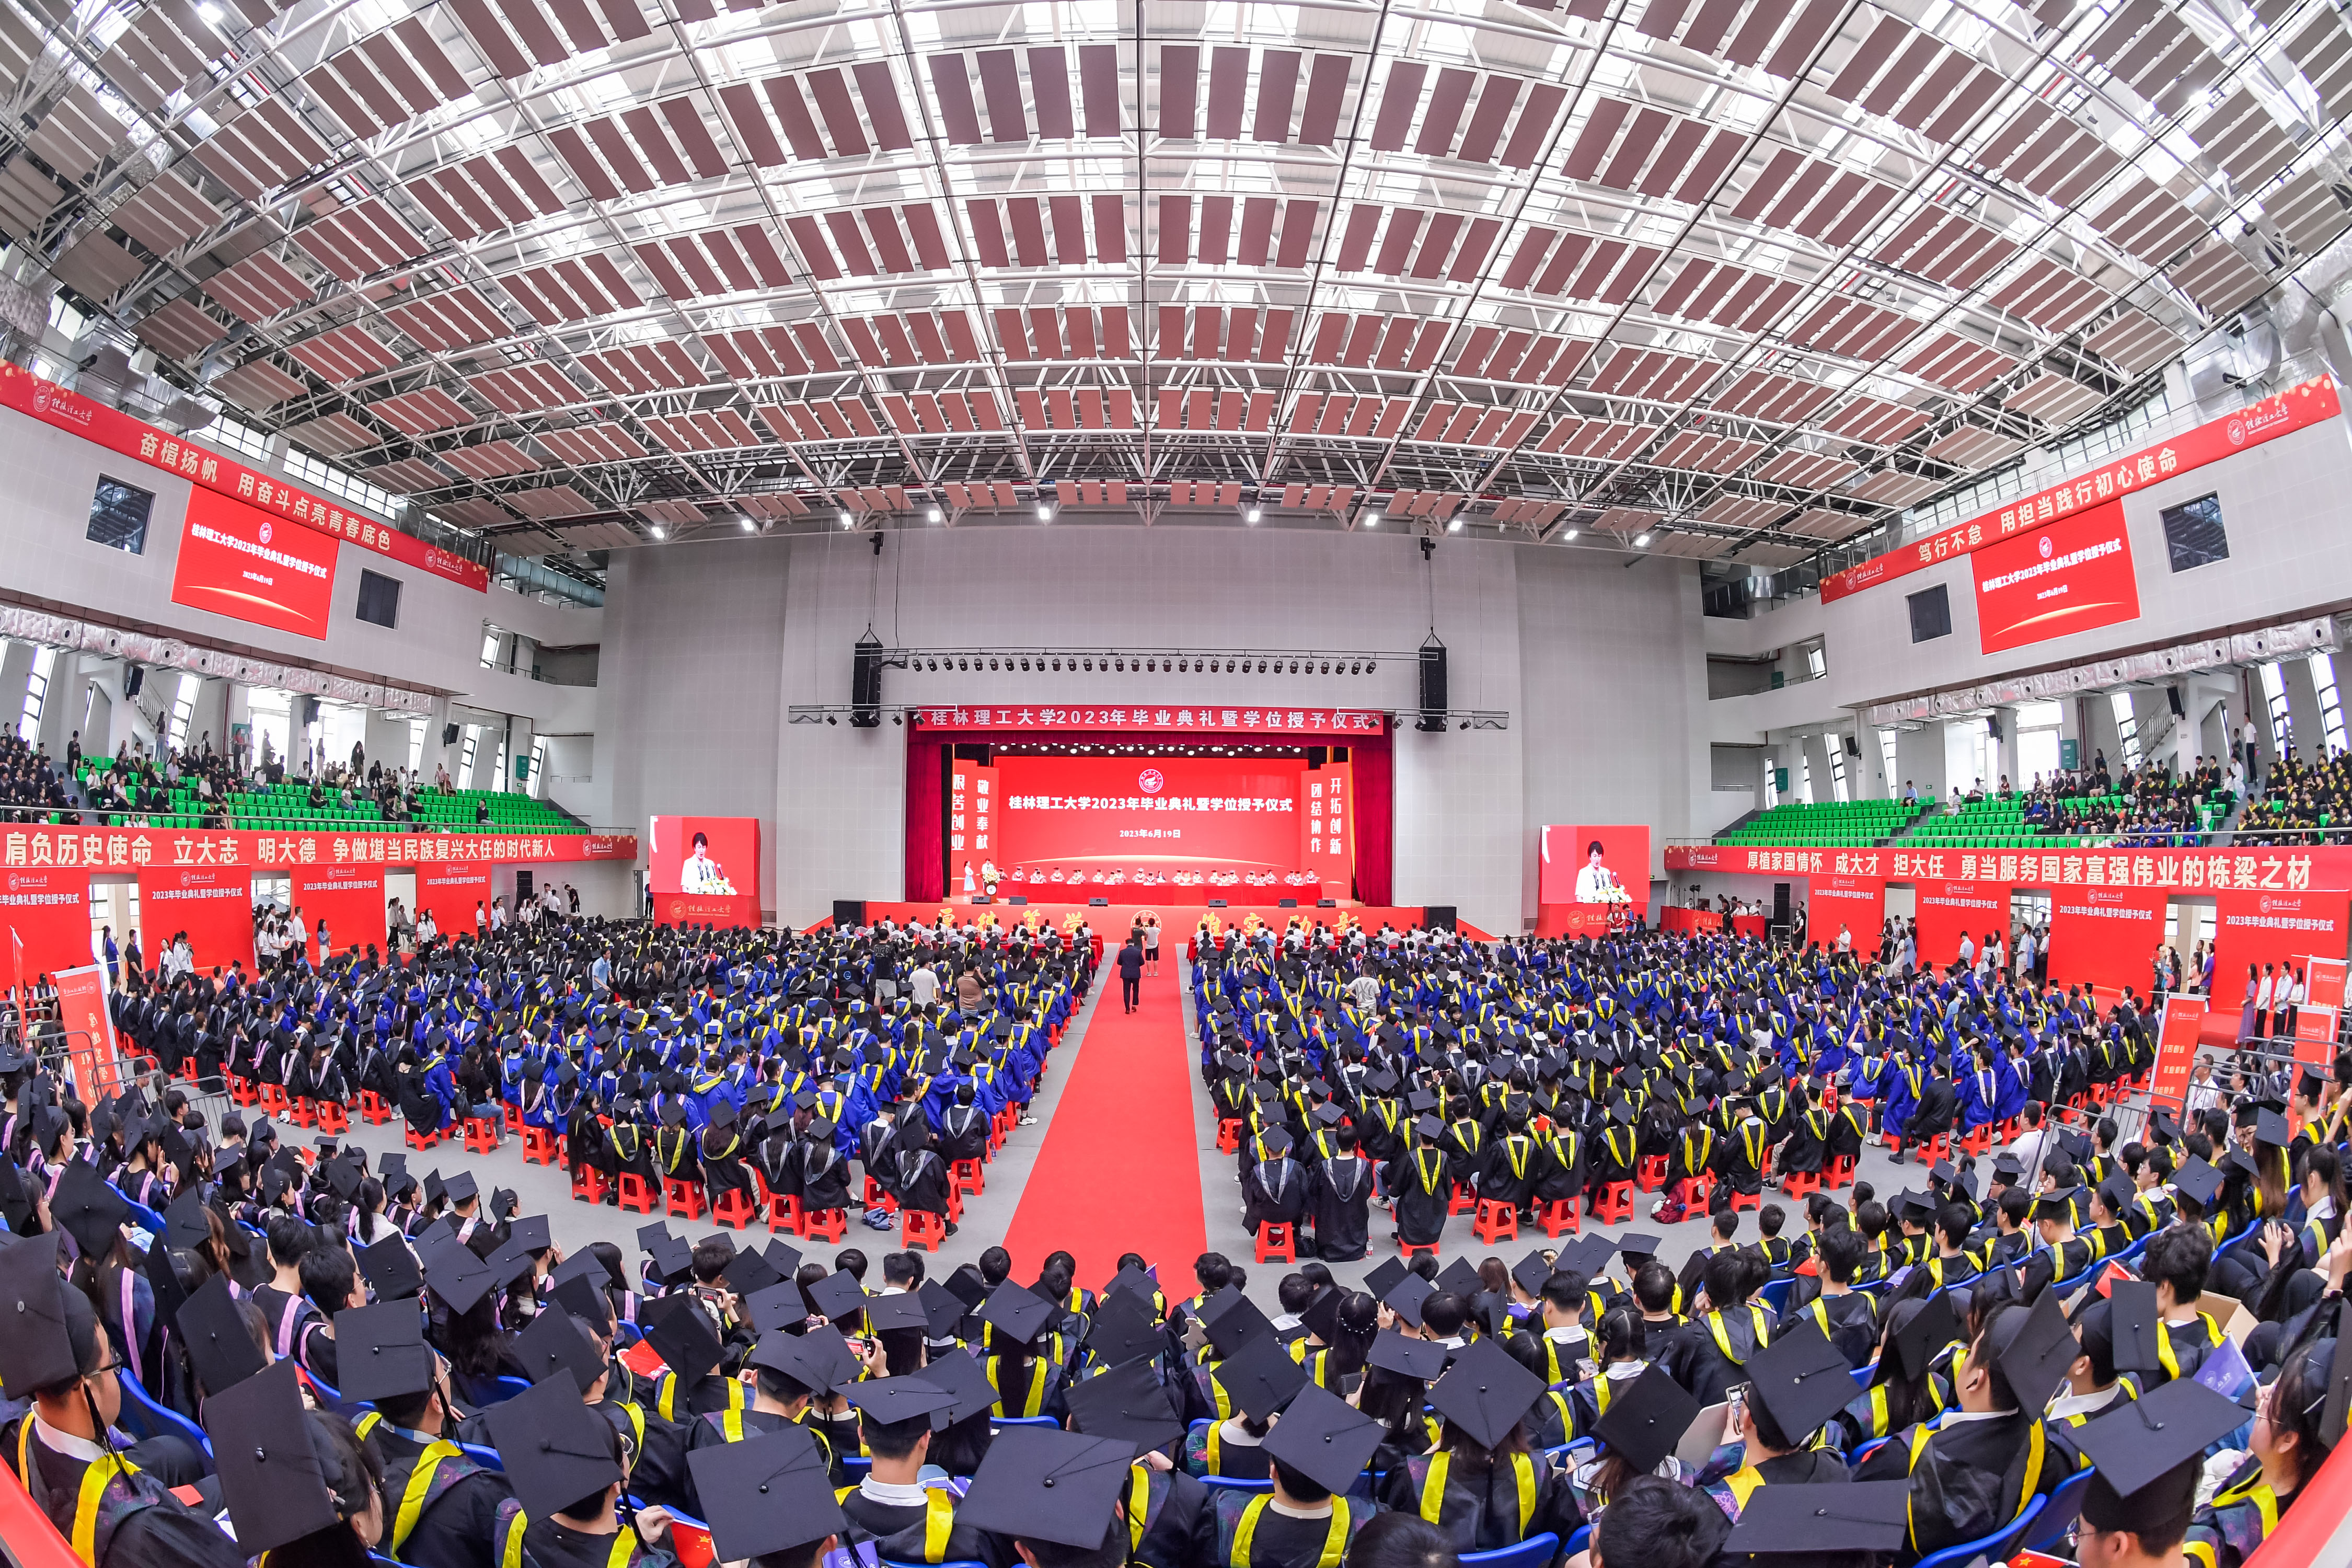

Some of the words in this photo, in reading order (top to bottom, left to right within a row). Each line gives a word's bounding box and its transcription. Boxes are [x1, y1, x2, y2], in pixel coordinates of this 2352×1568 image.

[140, 432, 217, 483] 奋楫扬帆
[237, 474, 390, 550] 用奋斗点亮青春底色
[1919, 524, 1982, 562] 笃行不怠
[2001, 447, 2177, 533] 用担当践行初心使命
[191, 523, 327, 579] 桂林理工大学2023年毕业典礼暨学位授予仪式
[1982, 538, 2122, 593] 桂林理工大学2023年毕业典礼暨学位授予仪式
[931, 708, 1369, 730] 桂林理工大学2023年毕业典礼暨学位授予仪式
[976, 779, 989, 849] 敬业奉献
[1009, 795, 1293, 812] 桂林理工大学2023年毕业典礼暨学位授予仪式
[1311, 783, 1322, 853] 团结协作
[1330, 778, 1341, 855] 开拓创新
[5, 831, 152, 866] 肩负历史使命
[174, 835, 239, 864] 立大志
[258, 837, 316, 863] 明大德
[333, 837, 555, 862] 争做堪当民族复兴大任的时代新人
[1120, 829, 1181, 838] 2023年6月19日
[1747, 851, 1823, 872] 厚植家国情怀
[1835, 852, 1880, 874] 成大才
[1894, 854, 1944, 877] 担大任
[1961, 855, 2312, 890] 勇当服务国家富强伟业的栋梁之材
[152, 887, 243, 900] 2023年毕业典礼暨学位授予仪式
[2059, 905, 2152, 920] 2023年毕业典礼暨学位授予仪式
[2226, 915, 2334, 931] 2023年毕业典礼暨学位授予仪式
